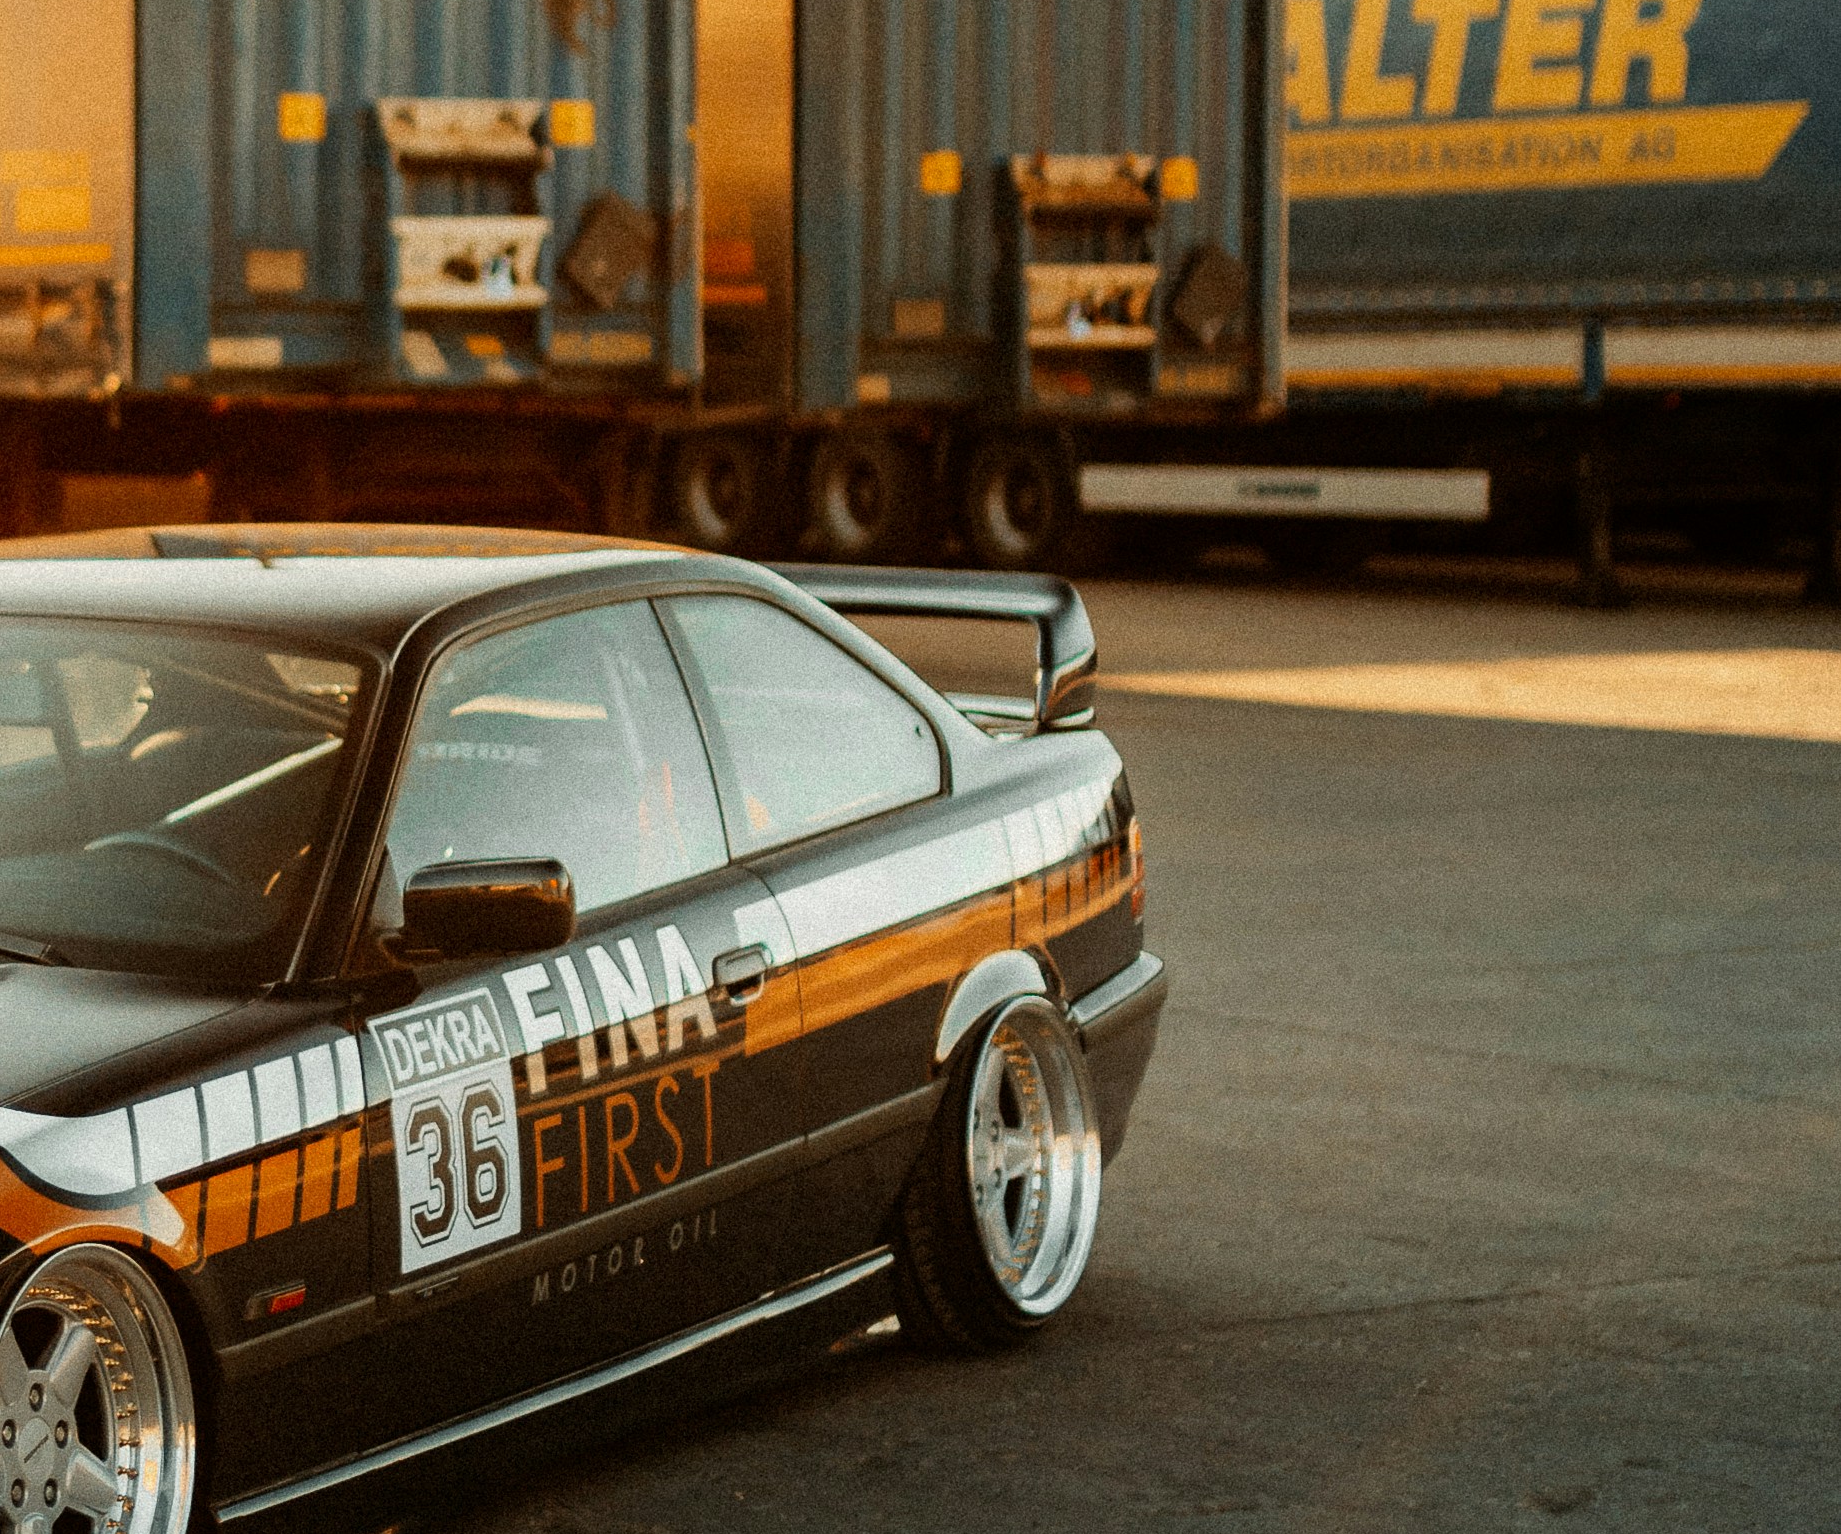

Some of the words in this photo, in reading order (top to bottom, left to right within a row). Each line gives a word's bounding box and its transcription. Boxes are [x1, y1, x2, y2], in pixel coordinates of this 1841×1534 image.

[384, 1003, 499, 1084] DEKRA
[502, 923, 718, 1095] FINA
[404, 1079, 510, 1249] 36
[533, 1058, 720, 1228] FIRST
[531, 1237, 645, 1306] MOTOR
[669, 1209, 717, 1252] OIL
